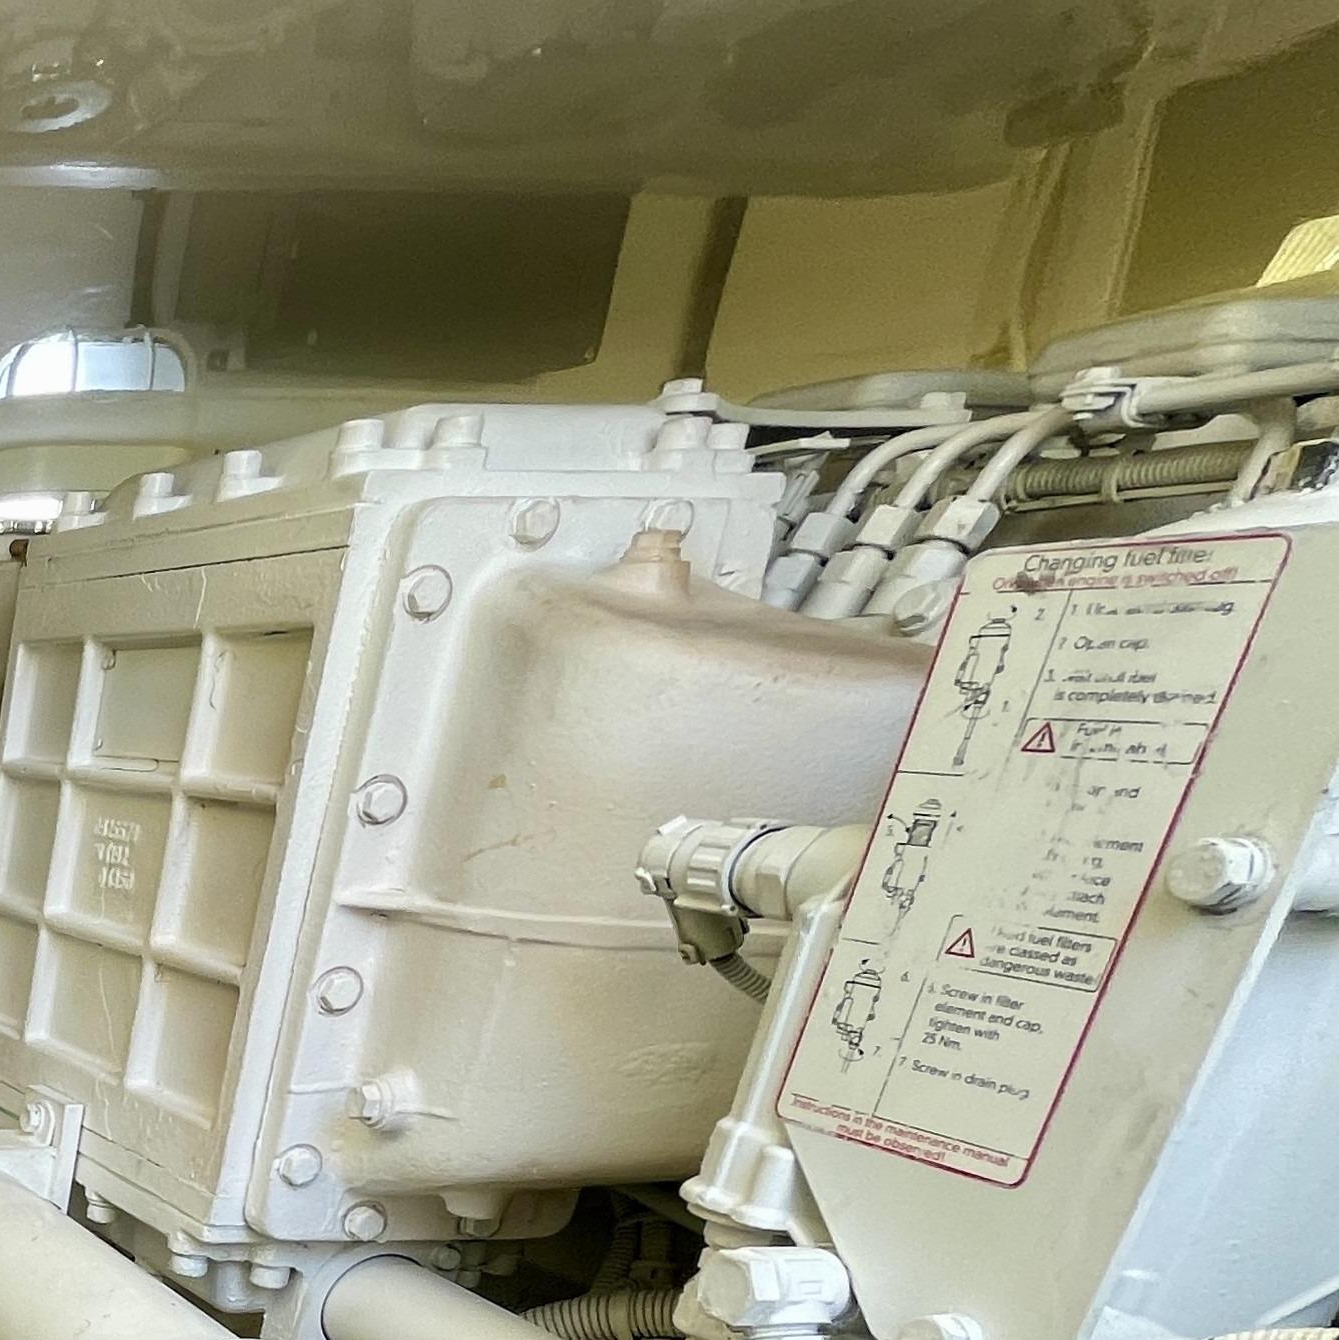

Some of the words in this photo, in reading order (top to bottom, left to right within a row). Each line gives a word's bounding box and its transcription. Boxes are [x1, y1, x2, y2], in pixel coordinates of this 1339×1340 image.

[1023, 554, 1118, 577] Changing
[1126, 547, 1167, 566] fuel
[1068, 690, 1151, 704] completely
[1056, 937, 1092, 953] filters
[979, 956, 1051, 977] dangerous
[1009, 947, 1060, 963] classed
[1061, 956, 1078, 966] as
[940, 984, 980, 1001] Screw
[980, 992, 993, 1004] in
[934, 1003, 986, 1021] element
[988, 1014, 1015, 1027] and
[921, 1032, 937, 1044] 25
[929, 1018, 971, 1035] tighten
[974, 1029, 1000, 1041] with
[911, 1060, 950, 1078] Screw
[964, 1073, 996, 1090] drain
[791, 1097, 851, 1121] Instructions
[864, 1117, 883, 1130] the
[885, 1125, 962, 1153] maintenance
[962, 1148, 1010, 1167] manual
[837, 1124, 864, 1138] must
[866, 1131, 881, 1142] be
